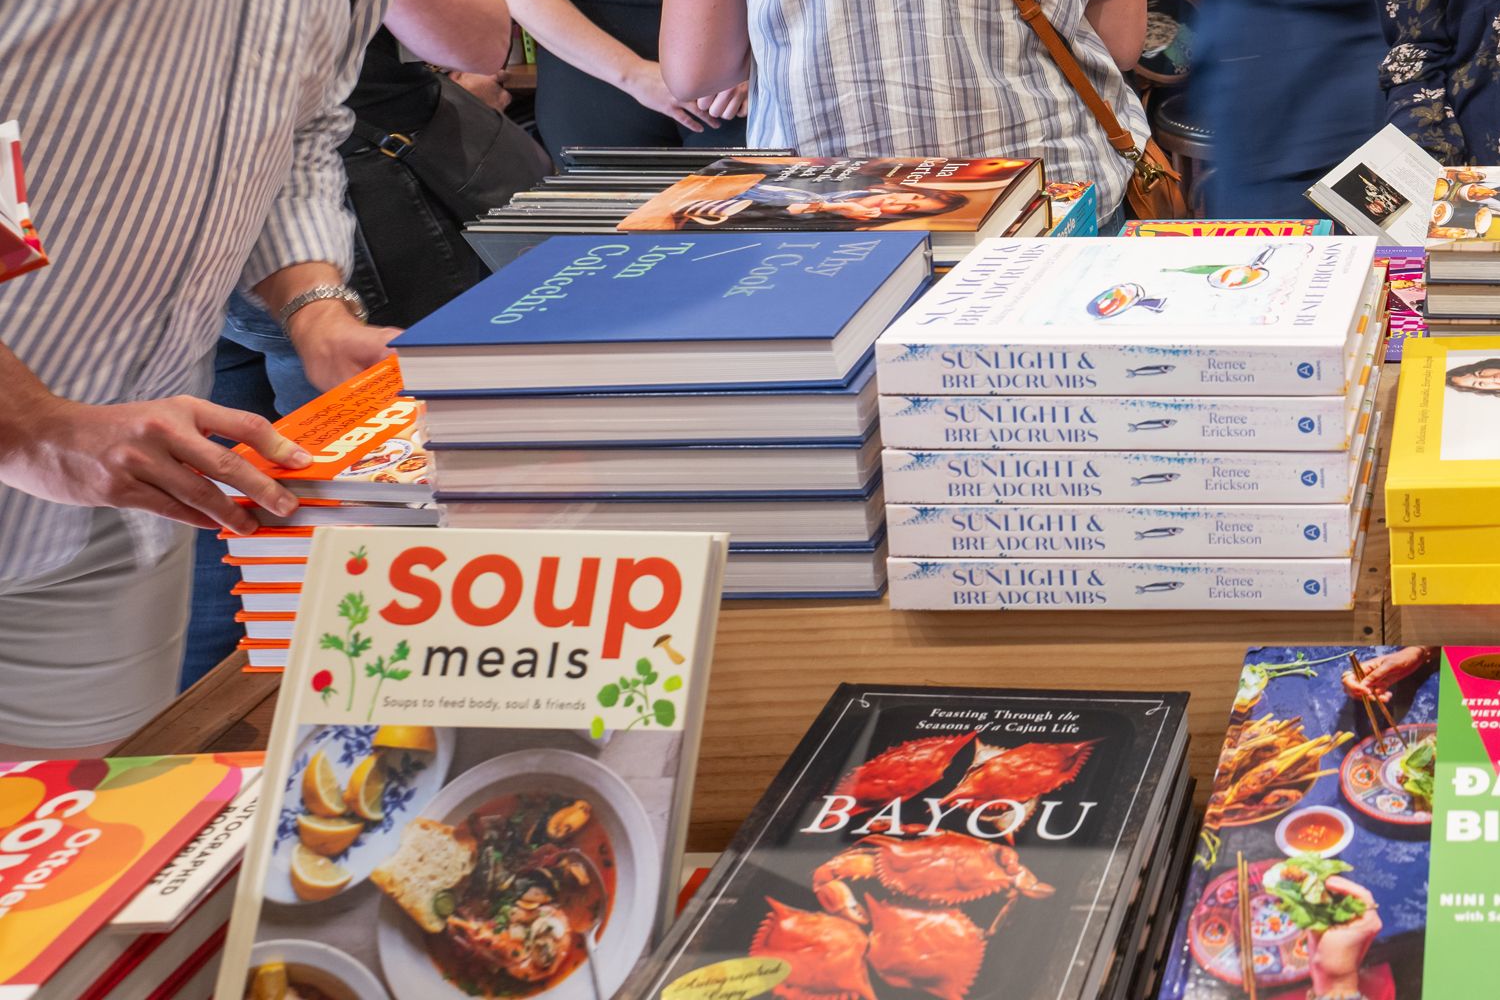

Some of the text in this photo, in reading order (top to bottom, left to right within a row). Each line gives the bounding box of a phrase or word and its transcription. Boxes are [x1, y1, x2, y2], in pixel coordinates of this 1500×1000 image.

[612, 242, 696, 280] Tom
[811, 238, 883, 277] Why
[490, 244, 631, 326] Colicchio
[722, 253, 804, 299] Cook
[940, 351, 1097, 370] SUNLIGHT &
[1206, 358, 1247, 371] Renee
[941, 373, 1097, 389] BREADCRUMBS
[1199, 370, 1255, 384] Erickson
[378, 545, 683, 660] soup
[421, 642, 589, 680] meals
[383, 696, 587, 713] Soups to feed body, soul & friends
[929, 707, 1080, 723] Feasting Through the
[914, 720, 1080, 735] Seasons of a Cajun Life
[800, 794, 1098, 841] BAYOU
[1440, 893, 1488, 908] NINI
[1454, 911, 1483, 923] with
